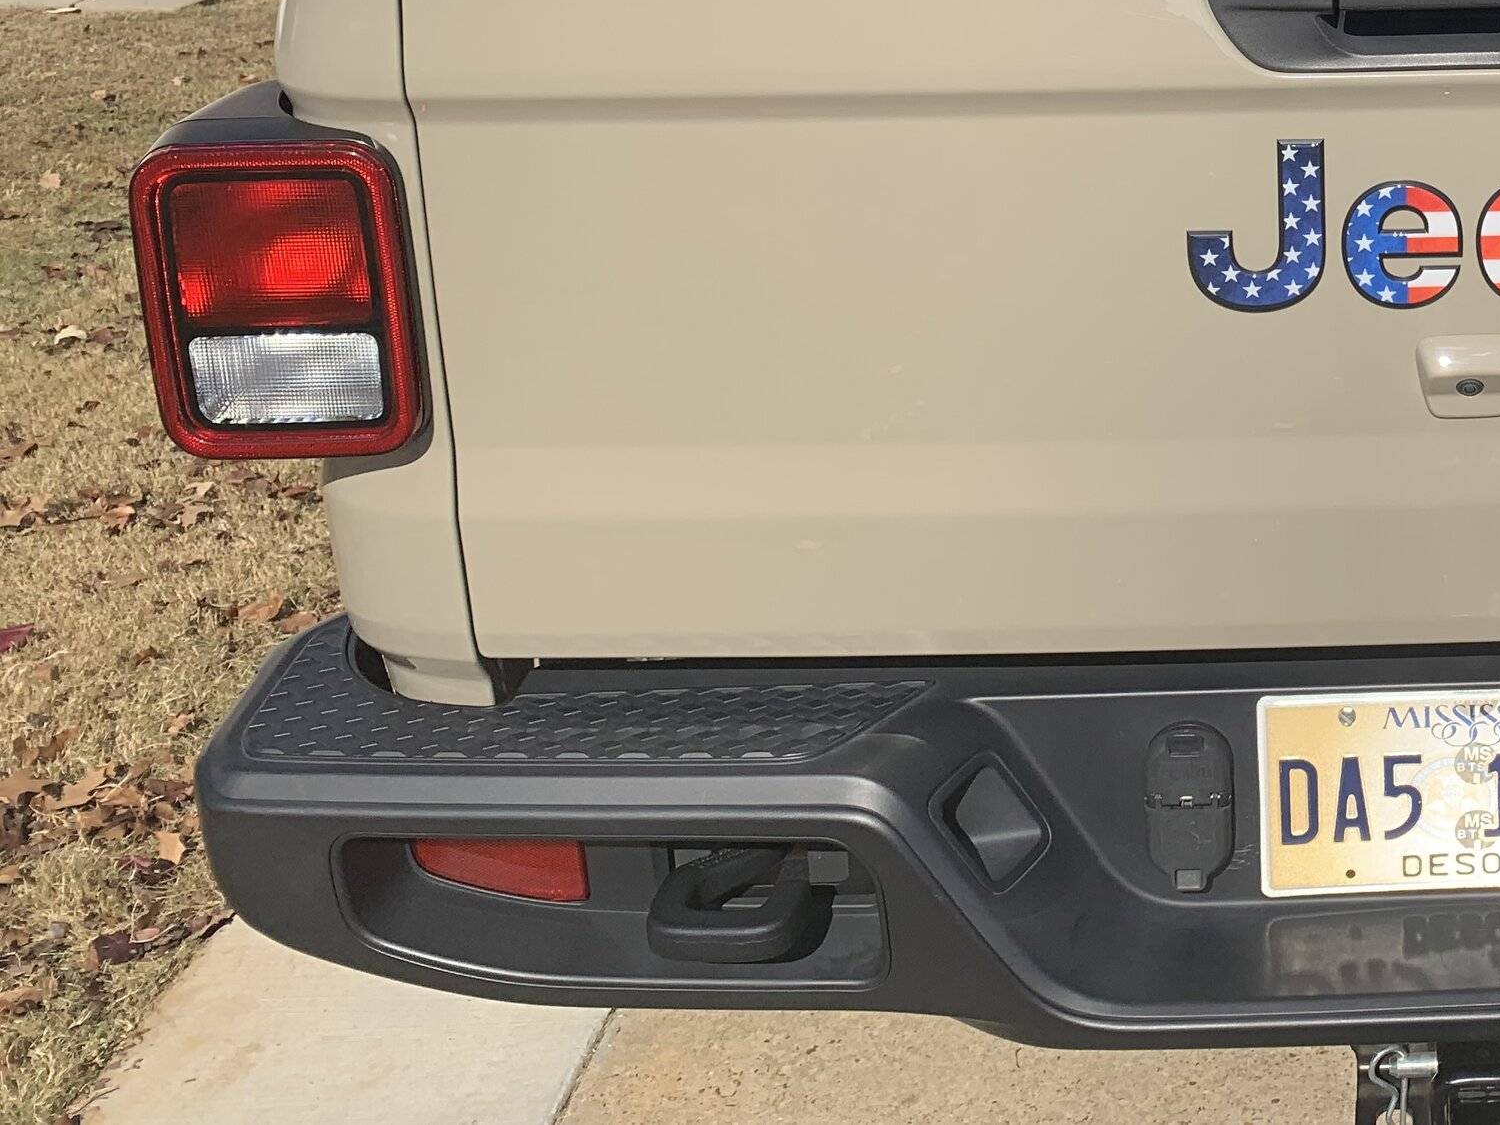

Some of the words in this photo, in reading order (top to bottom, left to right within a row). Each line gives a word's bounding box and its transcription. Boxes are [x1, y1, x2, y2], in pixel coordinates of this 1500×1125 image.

[1463, 746, 1493, 762] MS
[1278, 754, 1424, 846] DA5
[1464, 813, 1494, 828] MS
